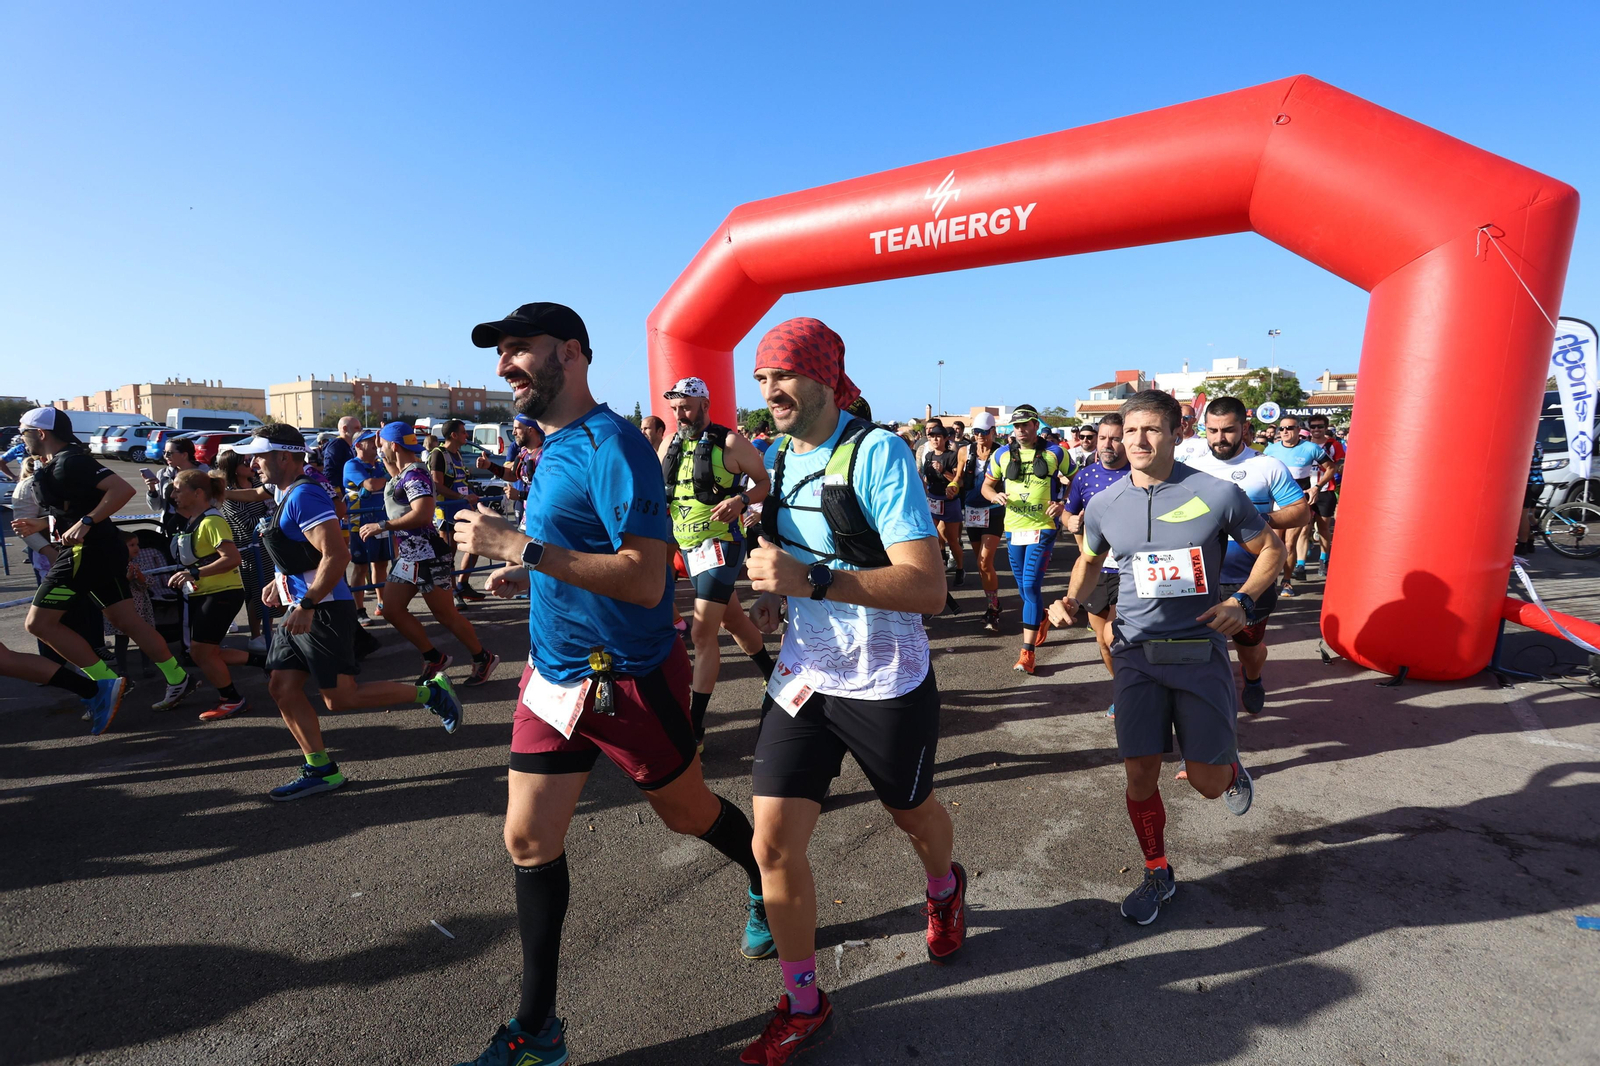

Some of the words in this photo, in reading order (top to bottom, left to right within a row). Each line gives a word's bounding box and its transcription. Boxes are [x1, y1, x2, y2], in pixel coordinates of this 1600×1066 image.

[869, 202, 1037, 255] TEAMERGY
[1285, 408, 1311, 416] TRAIL
[1147, 566, 1181, 582] 312
[1193, 554, 1205, 587] PIRATA
[567, 687, 587, 729] PIRATA
